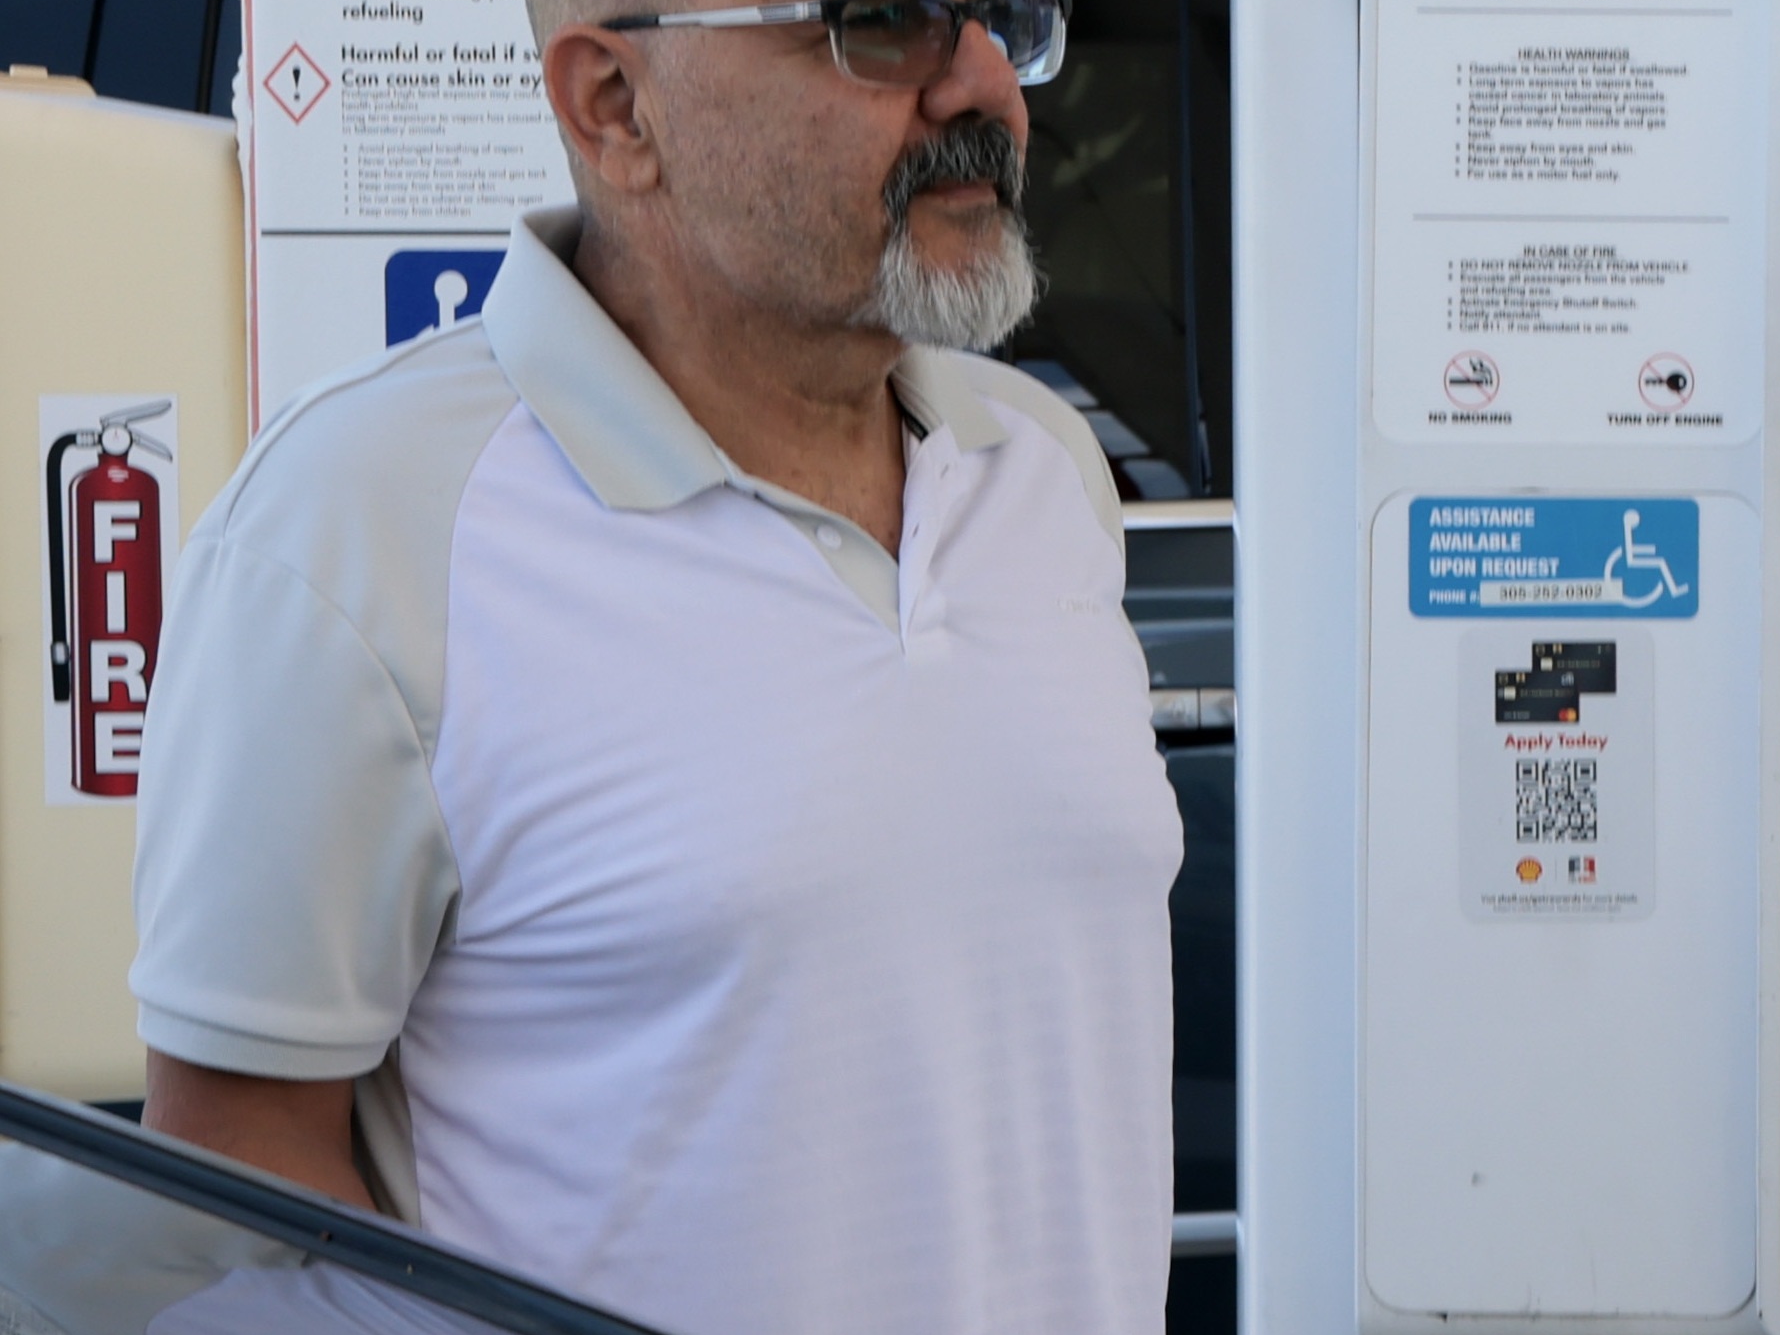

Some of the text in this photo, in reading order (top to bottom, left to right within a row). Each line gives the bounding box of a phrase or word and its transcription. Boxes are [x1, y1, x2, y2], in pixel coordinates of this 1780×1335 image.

[341, 44, 515, 62] Harmful or fatal if
[1428, 411, 1513, 425] NO SMOKING
[1607, 413, 1723, 426] TURN OFF ENGINE
[1429, 507, 1535, 527] ASSISTANCE
[1429, 532, 1522, 552] AVAILABLE
[1429, 557, 1559, 579] UPON REQUEST
[1429, 589, 1466, 604] PHONE
[88, 499, 149, 774] FIRE
[1504, 732, 1608, 752] Apply Today
